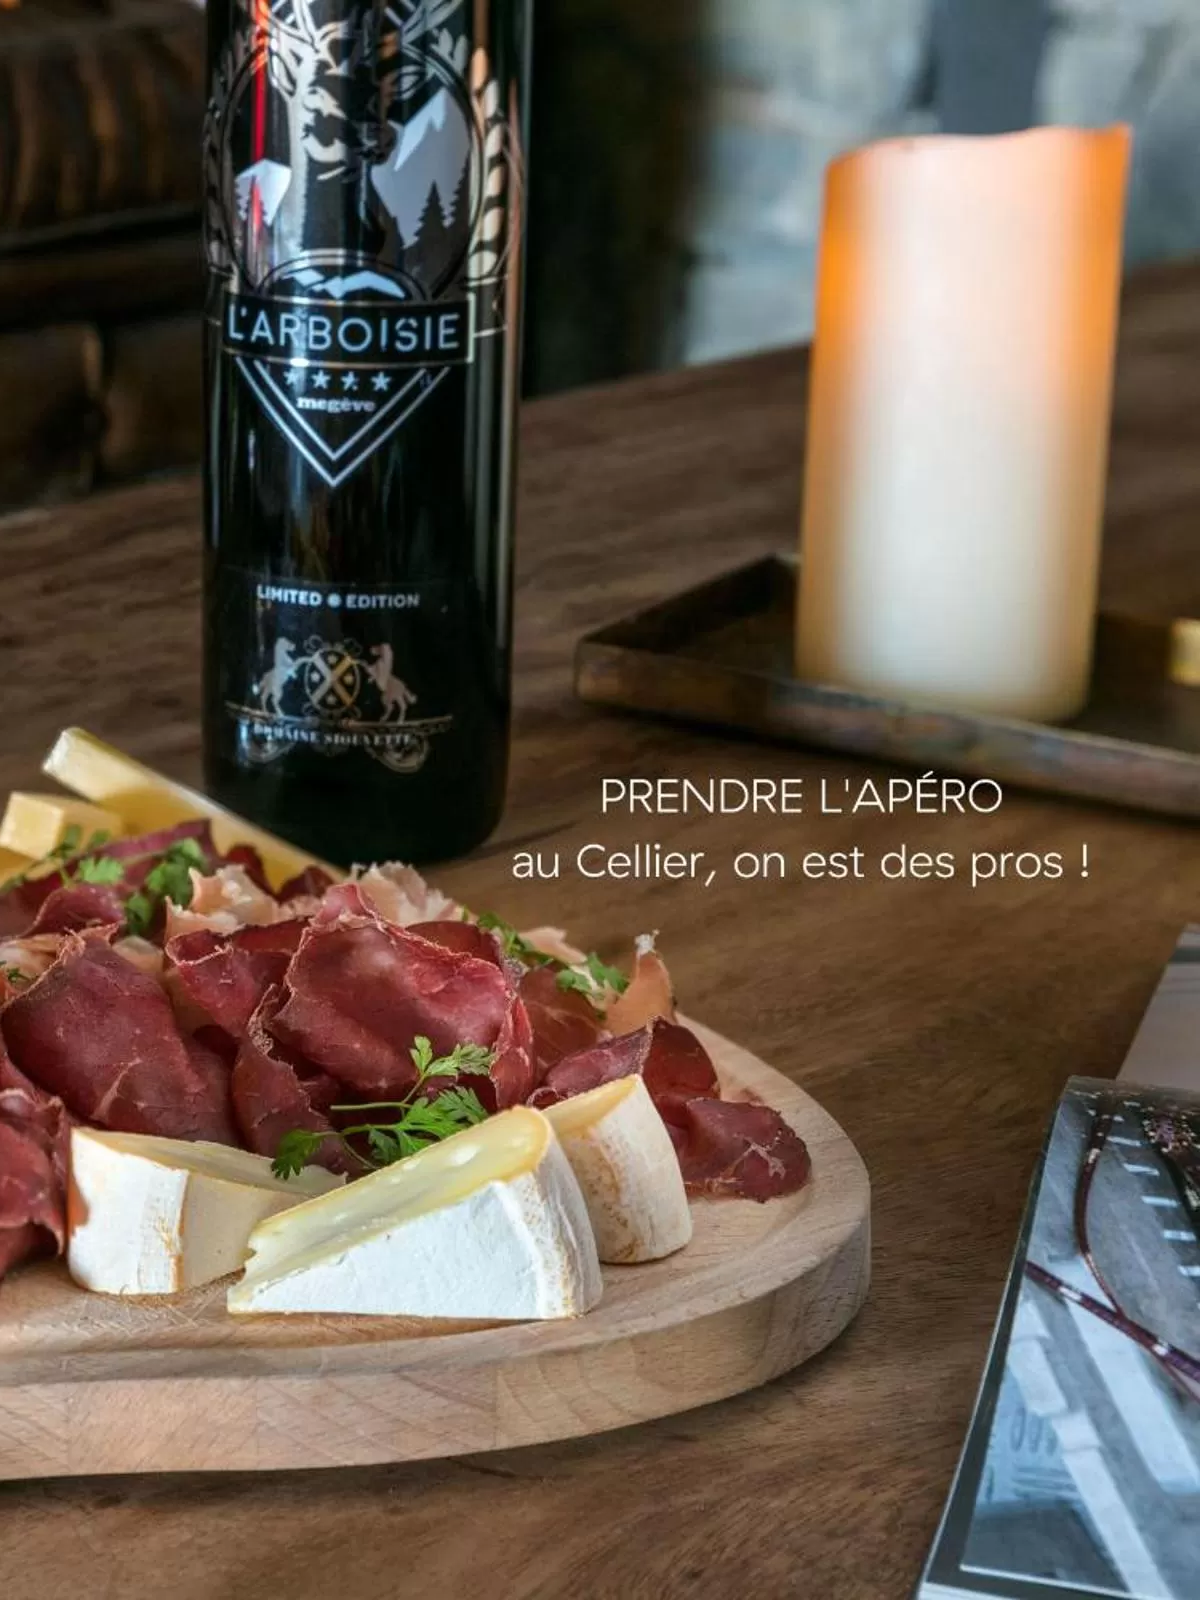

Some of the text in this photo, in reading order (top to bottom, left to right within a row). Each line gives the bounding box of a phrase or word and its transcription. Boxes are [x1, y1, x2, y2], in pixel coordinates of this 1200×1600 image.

[227, 303, 461, 352] L'ARBOISIE
[256, 584, 421, 609] LIMITED EDITION
